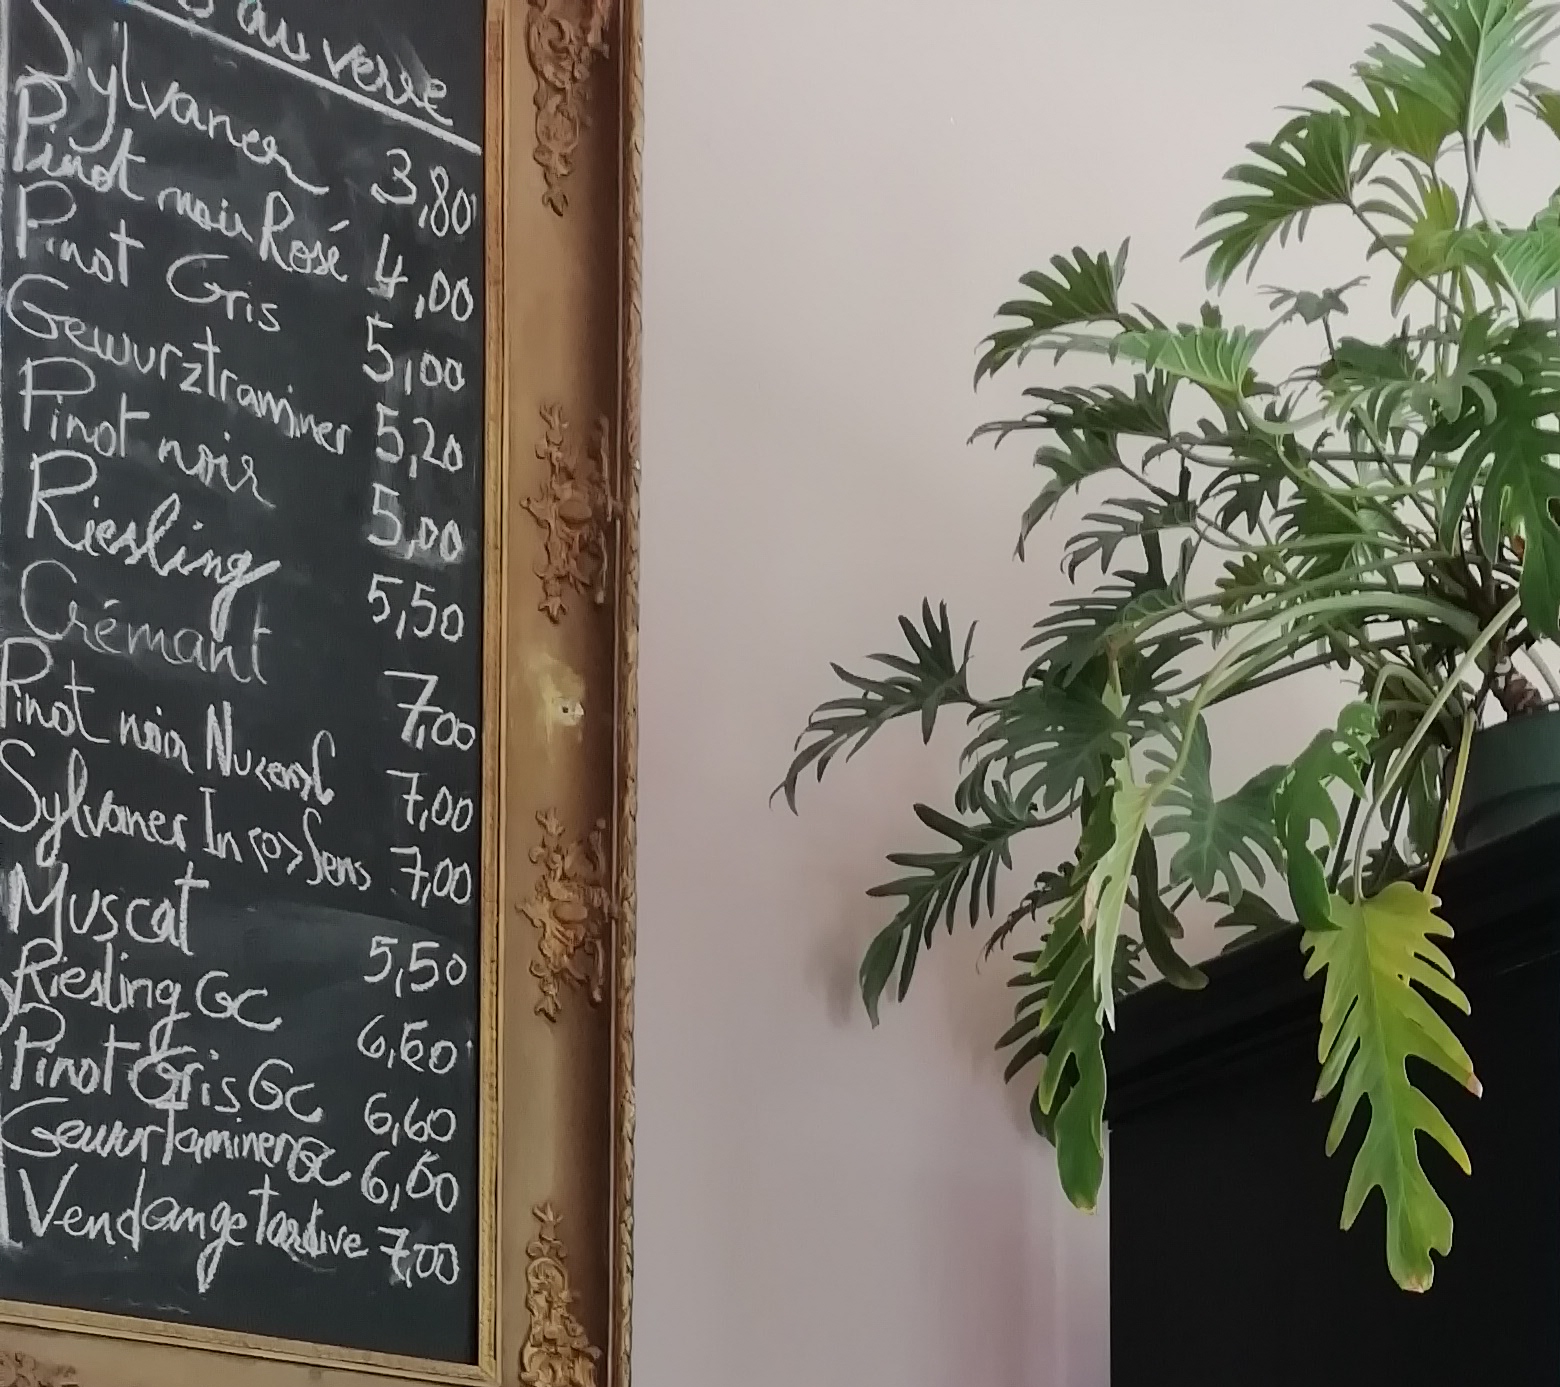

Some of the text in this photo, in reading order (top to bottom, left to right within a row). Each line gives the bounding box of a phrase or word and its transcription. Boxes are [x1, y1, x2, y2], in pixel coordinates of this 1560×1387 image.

[13, 75, 146, 201] Pinot
[158, 187, 254, 243] noir
[370, 234, 475, 321] 4,00
[371, 148, 473, 237] 3,80
[17, 180, 466, 394] Pinot Gris 5,00
[19, 356, 464, 562] Pinot noir 5,00
[376, 401, 464, 478] 5,20
[27, 449, 465, 642] Riesling 5,50
[21, 558, 476, 750] Crémant 7,00
[0, 637, 111, 744] Pinot
[118, 706, 195, 775] noir
[386, 769, 474, 833] 7,00
[0, 738, 188, 867] Sylvaner
[389, 846, 472, 907] 7,00
[8, 861, 467, 997] Muscat 5,50
[12, 937, 457, 1074] Riesling GC 6,60
[11, 1003, 457, 1146] Pinot Gris GC 6,60
[19, 1163, 460, 1293] Vendange tardive 7,00
[361, 1149, 459, 1213] 6,60
